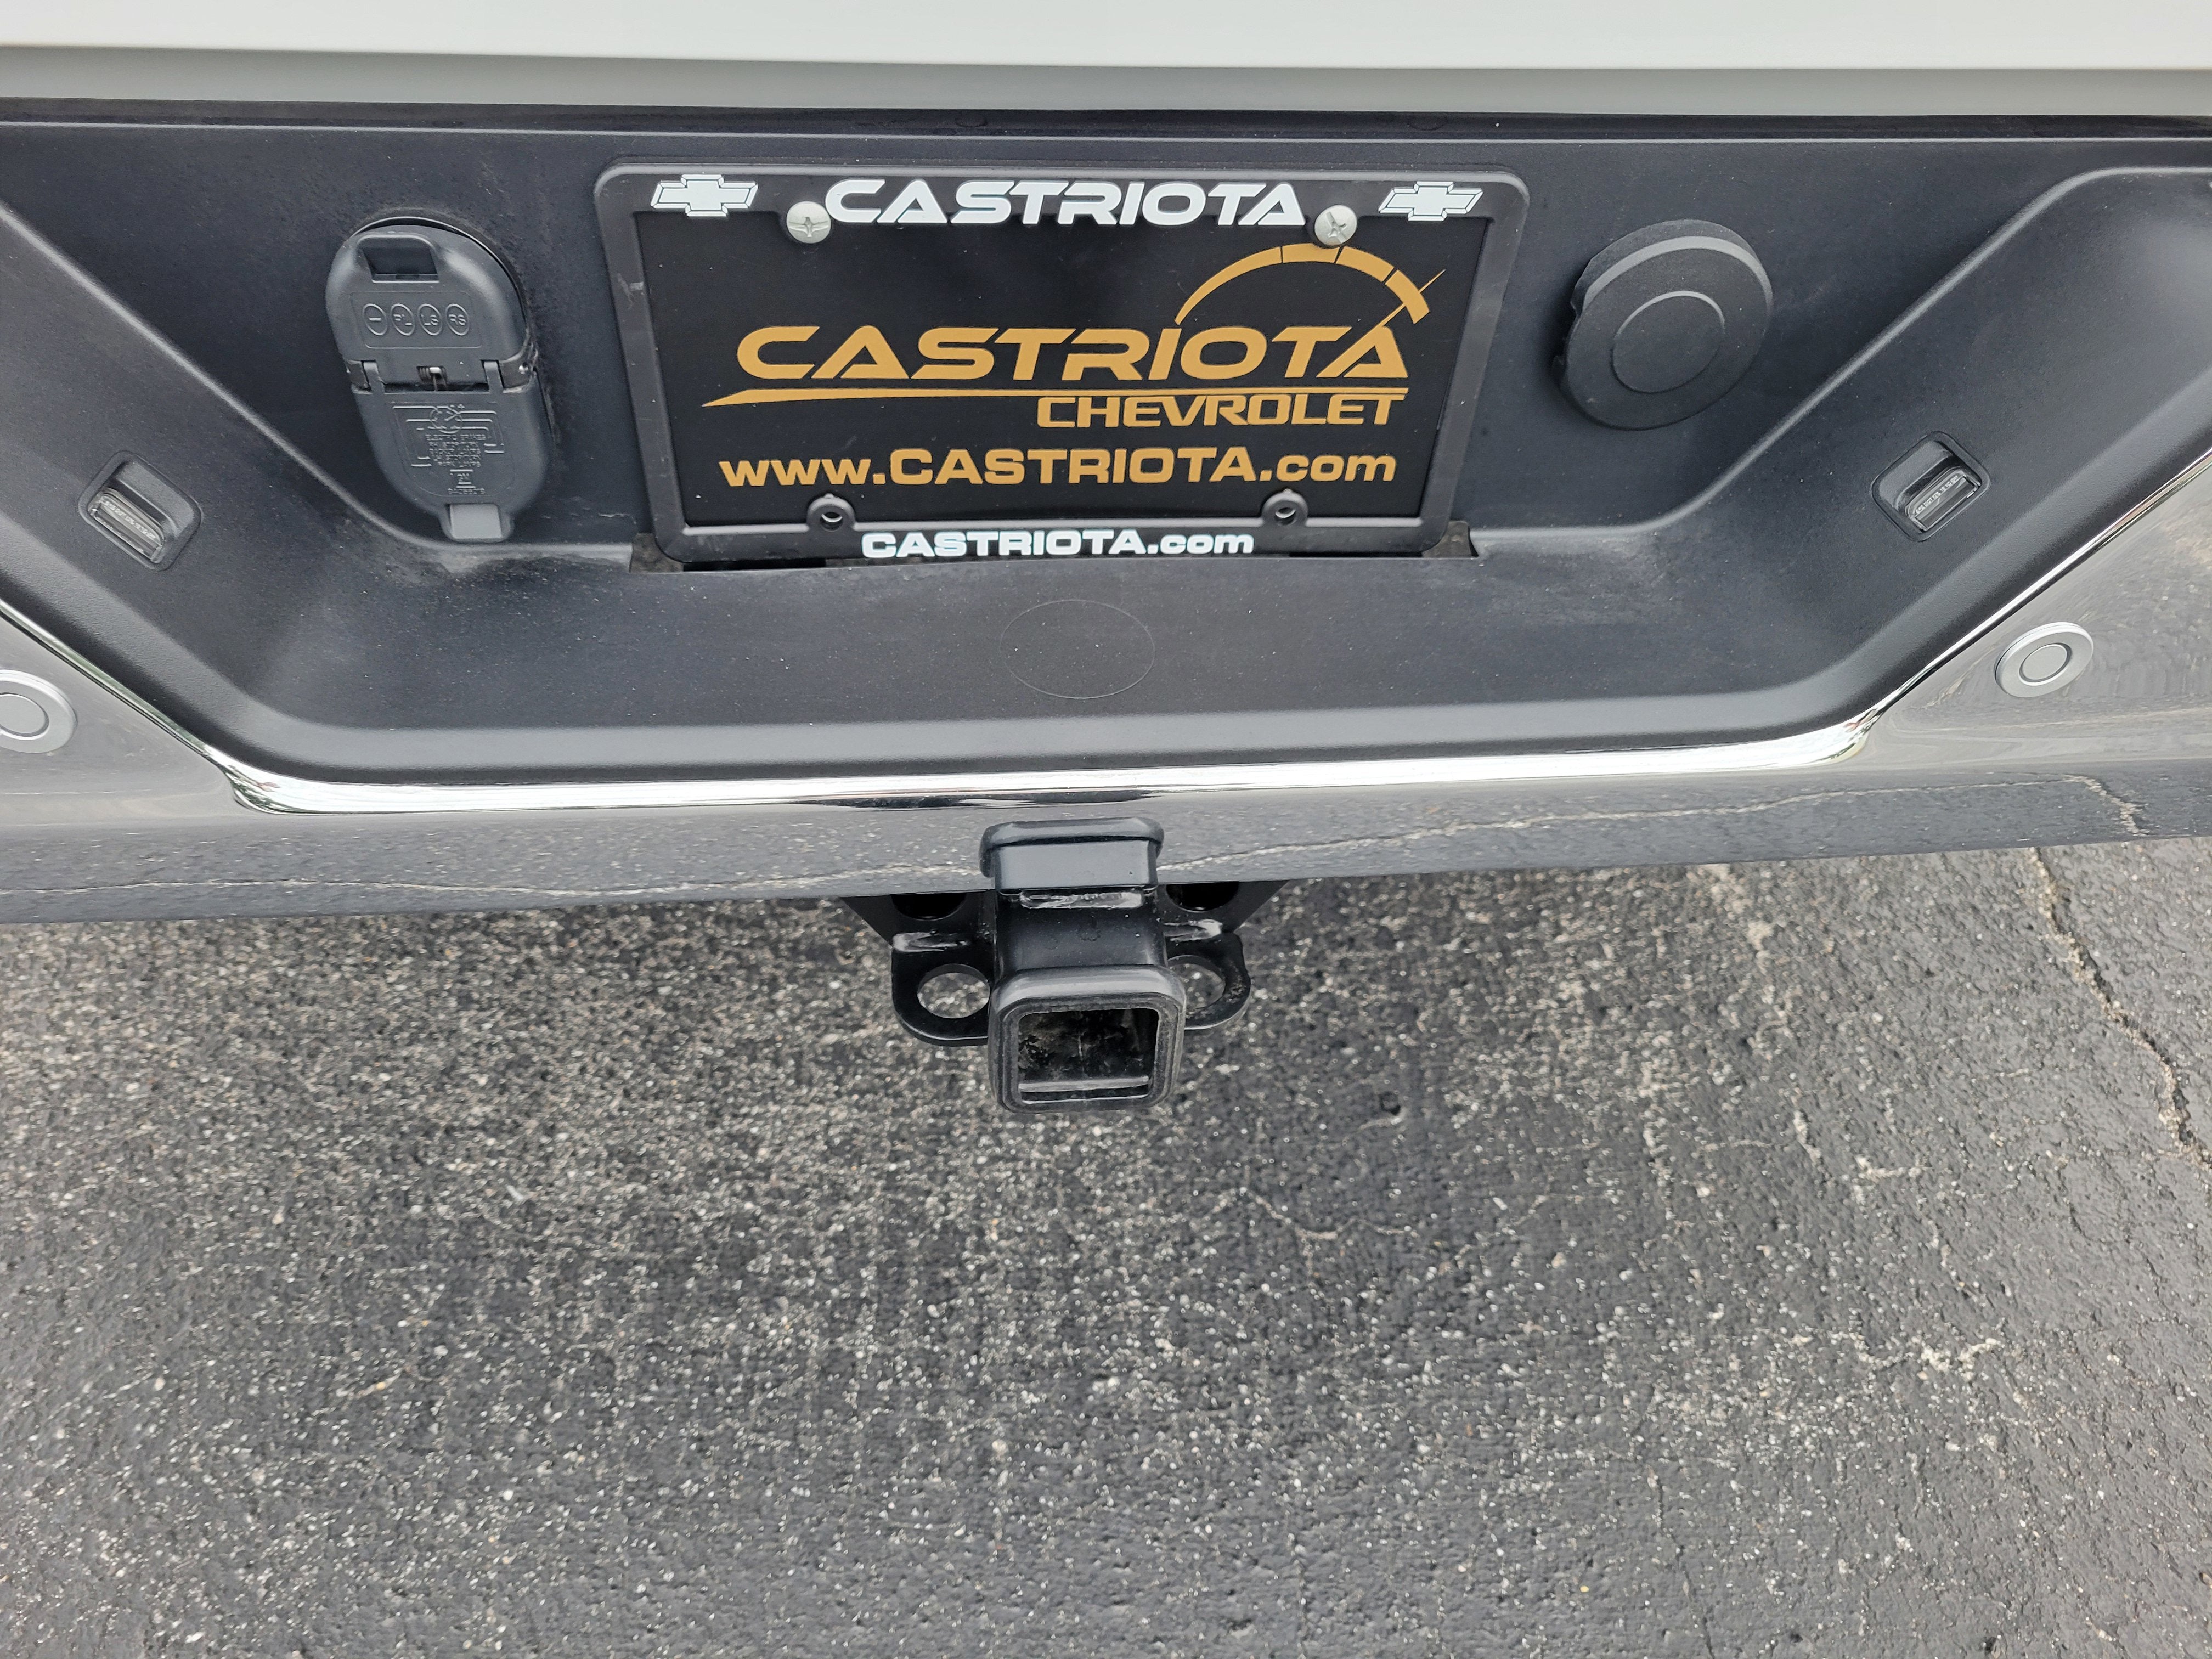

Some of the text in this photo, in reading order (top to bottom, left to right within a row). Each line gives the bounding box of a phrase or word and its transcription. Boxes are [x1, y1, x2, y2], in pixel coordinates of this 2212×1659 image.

[825, 179, 1306, 226] CASTRIOTA
[448, 314, 466, 326] RS
[737, 325, 1408, 381] CASTRIOTA
[1037, 393, 1405, 428] CHEVROLET
[719, 447, 1397, 487] www.CASTRIOTA.com
[861, 529, 1254, 558] CASTRIOTA.com
